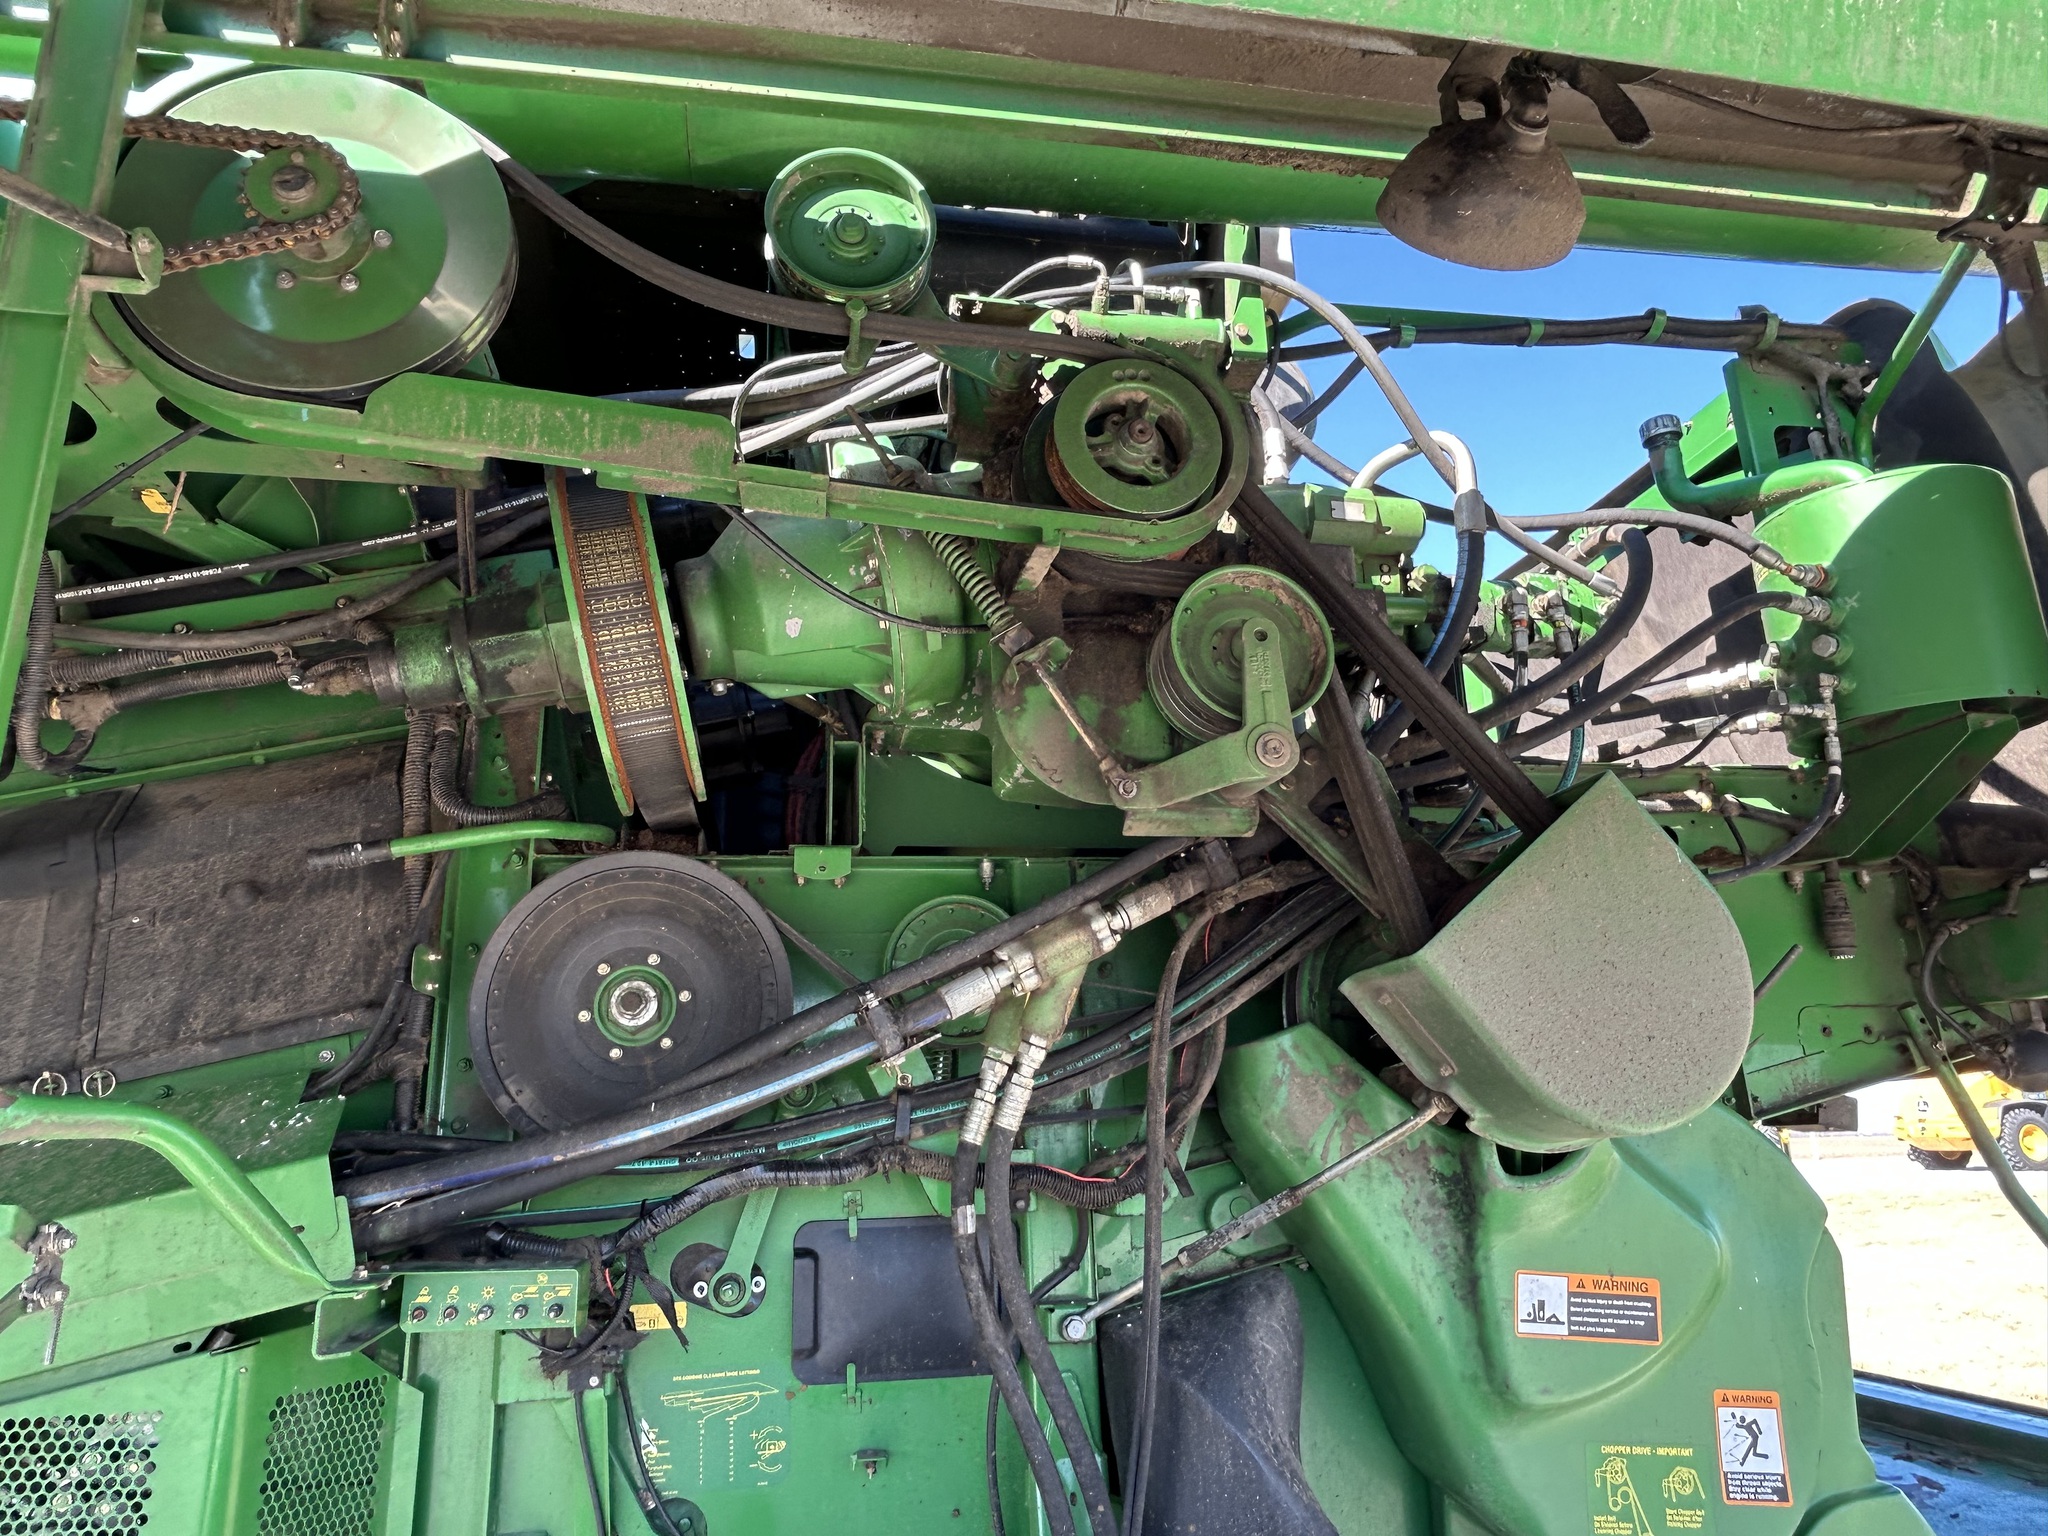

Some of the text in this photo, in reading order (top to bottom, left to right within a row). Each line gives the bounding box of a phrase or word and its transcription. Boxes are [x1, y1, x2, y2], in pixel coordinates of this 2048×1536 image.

[1592, 1279, 1649, 1293] WARNING
[1731, 1394, 1773, 1404] WARNING
[1601, 1445, 1631, 1455] CHOPPER
[1632, 1446, 1651, 1455] DRIVE
[1656, 1446, 1693, 1457] IMPORTANT
